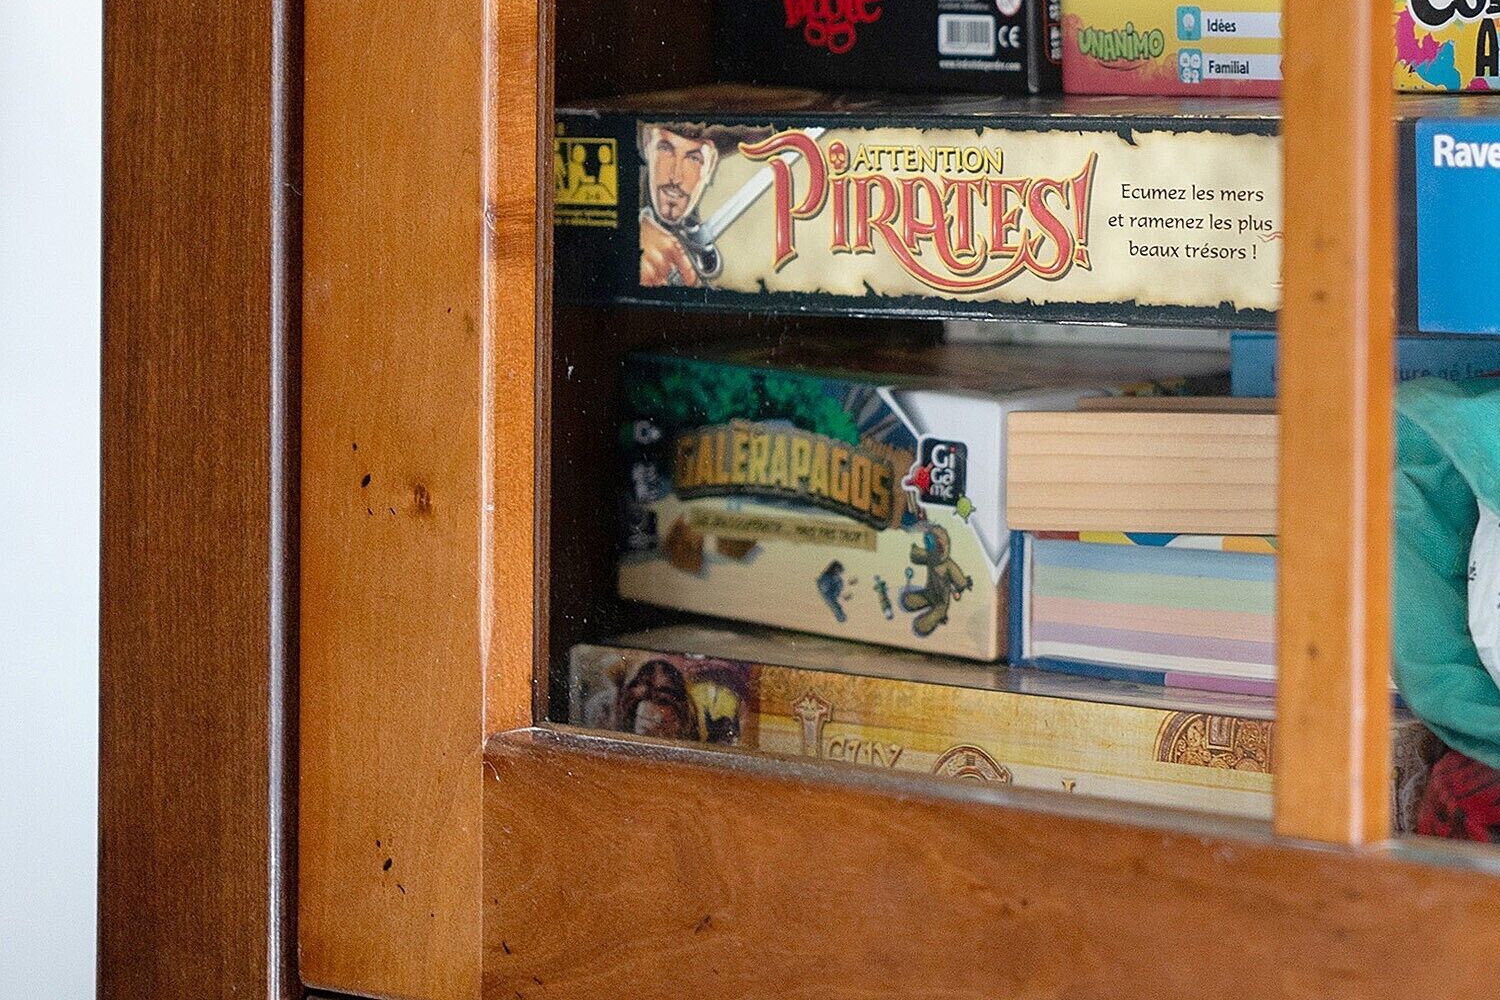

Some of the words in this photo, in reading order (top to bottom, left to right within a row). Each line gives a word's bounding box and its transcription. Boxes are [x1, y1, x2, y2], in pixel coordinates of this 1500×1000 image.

[1207, 18, 1237, 34] Idées
[1208, 59, 1250, 75] Familial
[853, 143, 1004, 175] ATTENTION
[1121, 183, 1187, 200] Ecumez
[1191, 184, 1215, 201] les
[1219, 188, 1265, 202] mers
[1107, 213, 1125, 228] et
[1129, 216, 1204, 230] ramenez
[1209, 213, 1233, 231] les
[1237, 214, 1274, 234] plus
[1128, 239, 1180, 258] beaux
[1184, 242, 1247, 260] trésors
